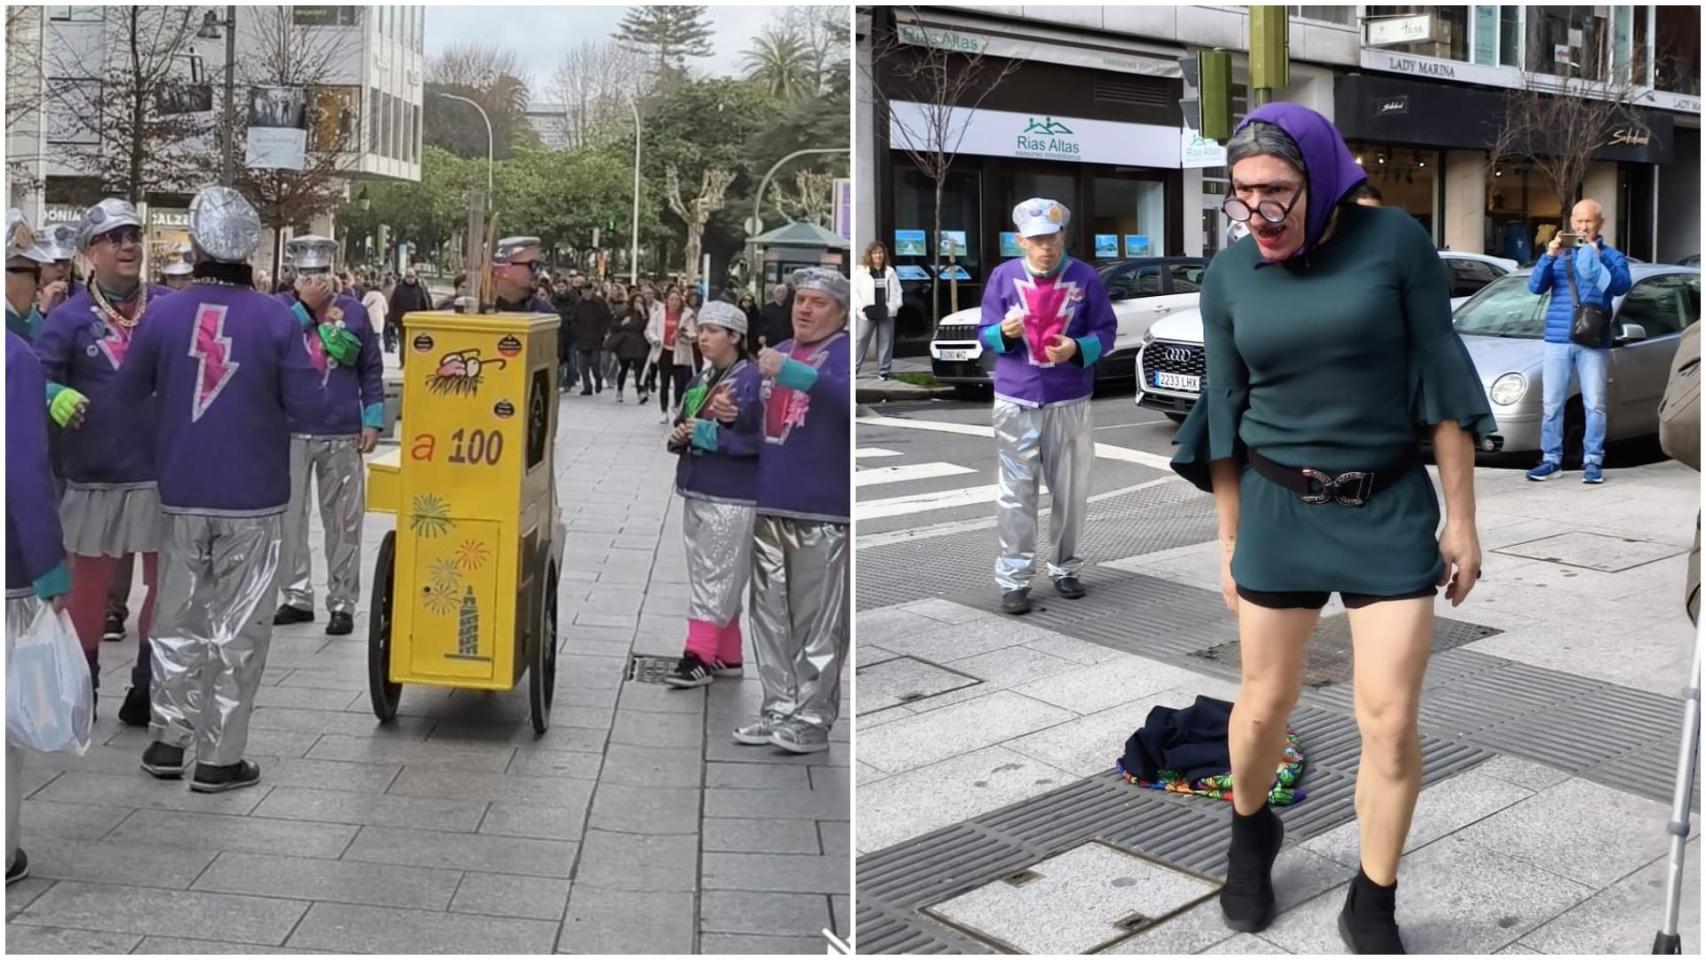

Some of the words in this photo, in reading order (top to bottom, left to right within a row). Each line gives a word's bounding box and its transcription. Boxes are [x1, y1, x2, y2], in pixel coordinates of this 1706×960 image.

[942, 31, 978, 51] Altas
[1390, 57, 1416, 72] LADY
[1418, 62, 1456, 78] MARINA
[1017, 136, 1046, 151] Rias
[1048, 138, 1080, 154] Altas
[1161, 375, 1180, 386] 2233
[410, 432, 436, 462] a
[448, 428, 504, 466] 100
